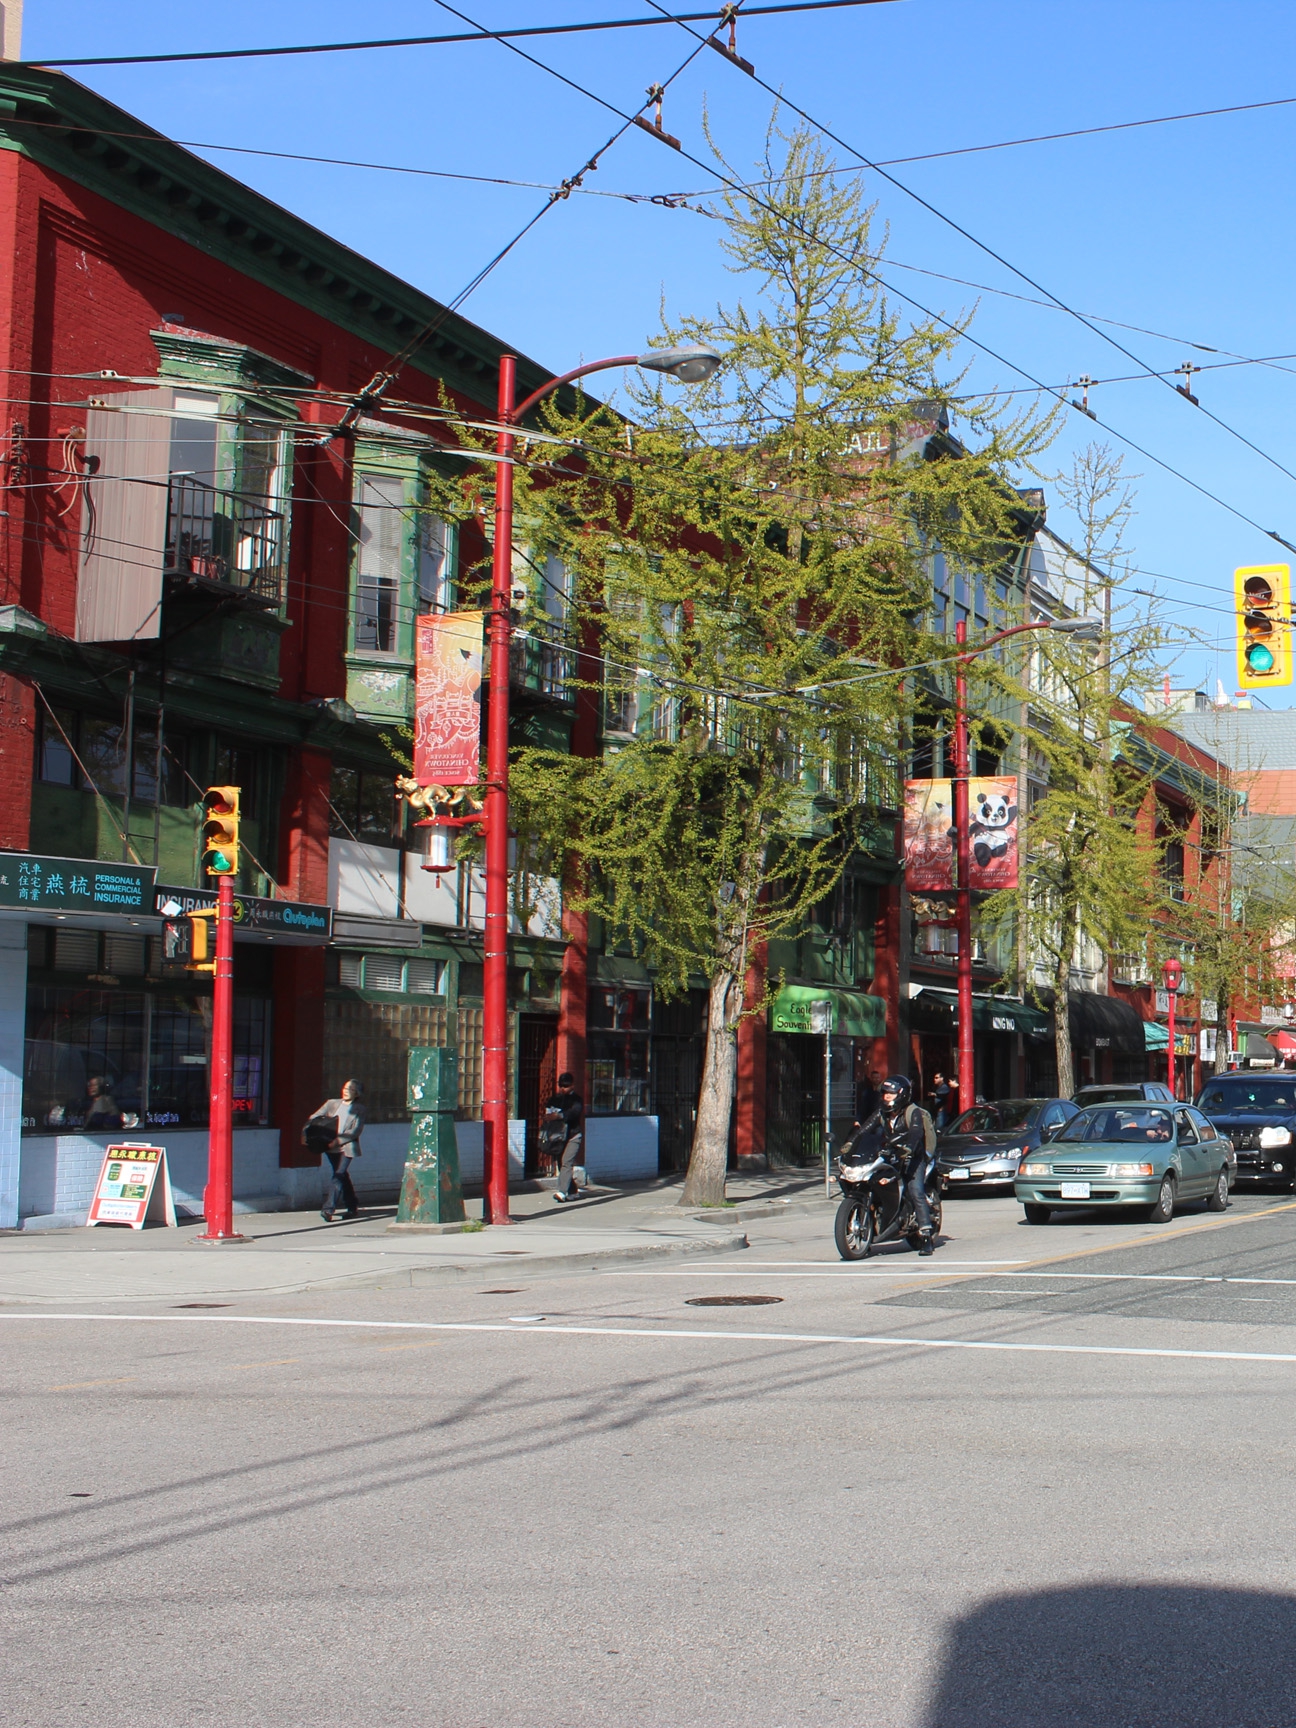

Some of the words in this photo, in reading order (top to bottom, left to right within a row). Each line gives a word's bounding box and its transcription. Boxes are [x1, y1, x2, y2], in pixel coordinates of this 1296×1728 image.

[95, 874, 135, 886] PERSONAL
[94, 883, 142, 895] COMMERCIAL
[94, 892, 142, 906] INSURANCE
